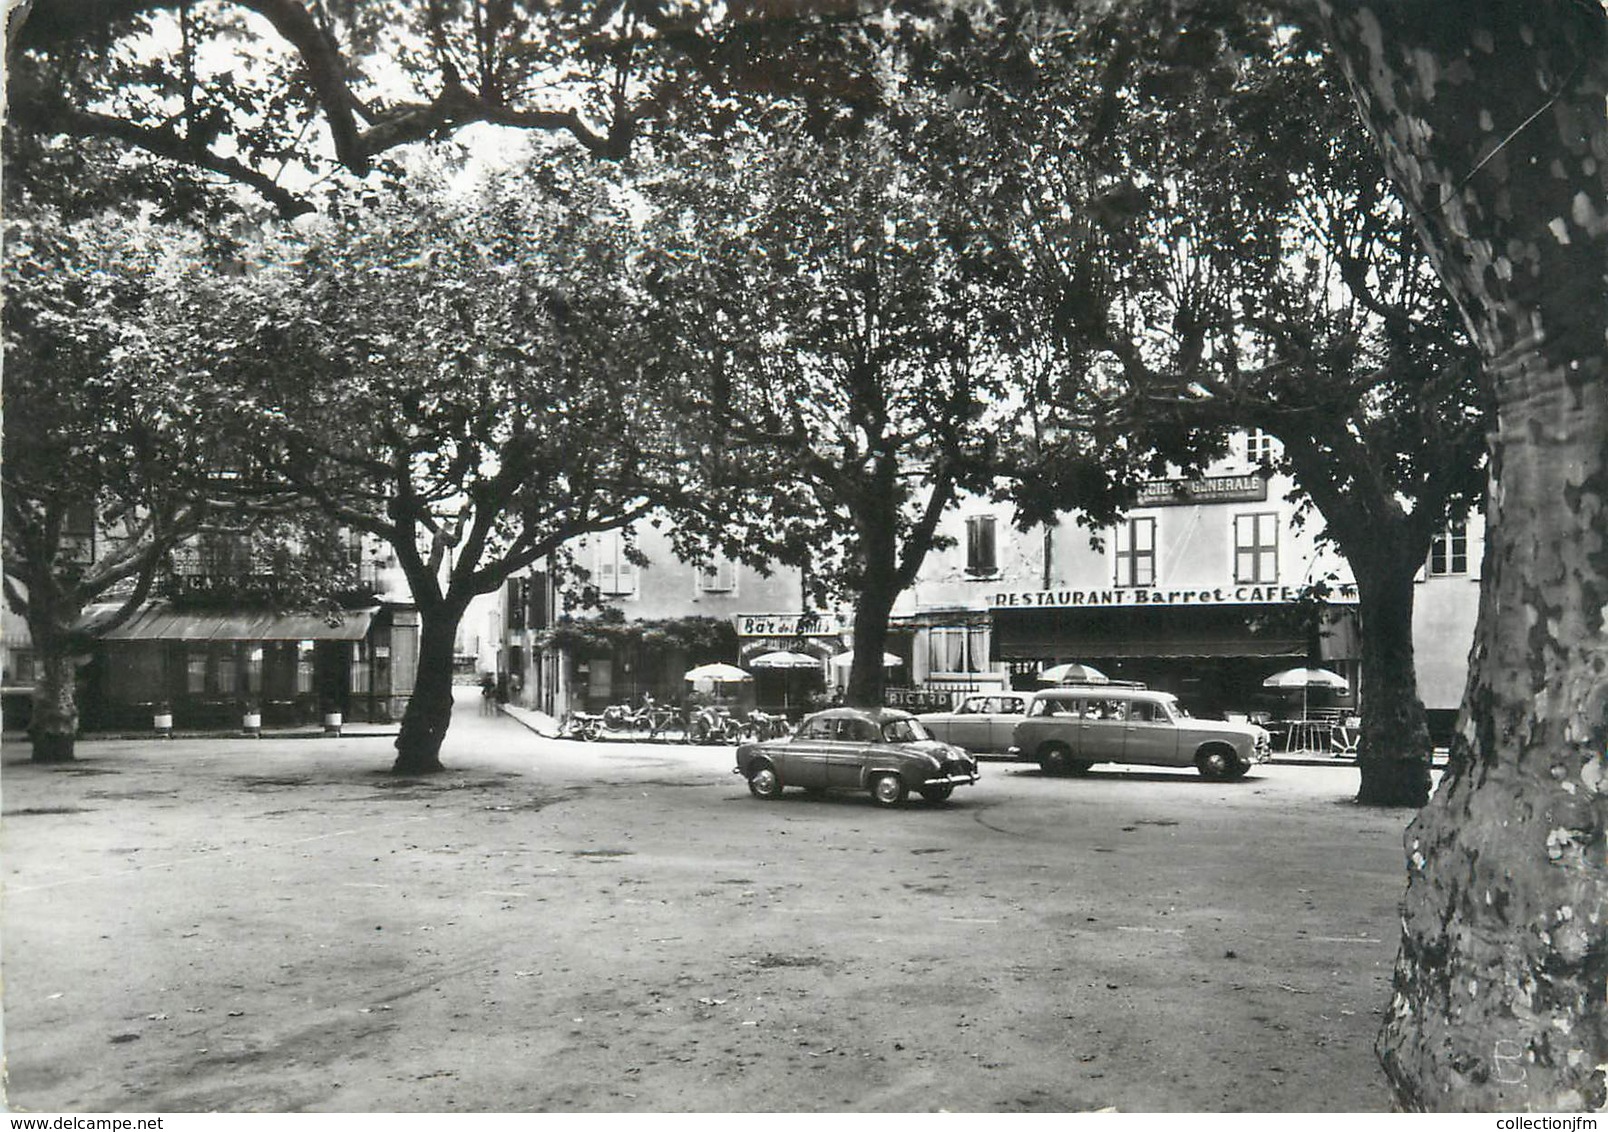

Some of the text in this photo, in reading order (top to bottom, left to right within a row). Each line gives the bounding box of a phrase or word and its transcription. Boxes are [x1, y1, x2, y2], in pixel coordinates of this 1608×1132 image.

[995, 590, 1125, 606] RESTAURANT
[1134, 588, 1226, 604] Barret
[744, 618, 774, 634] Bar
[889, 693, 947, 705] RICARD
